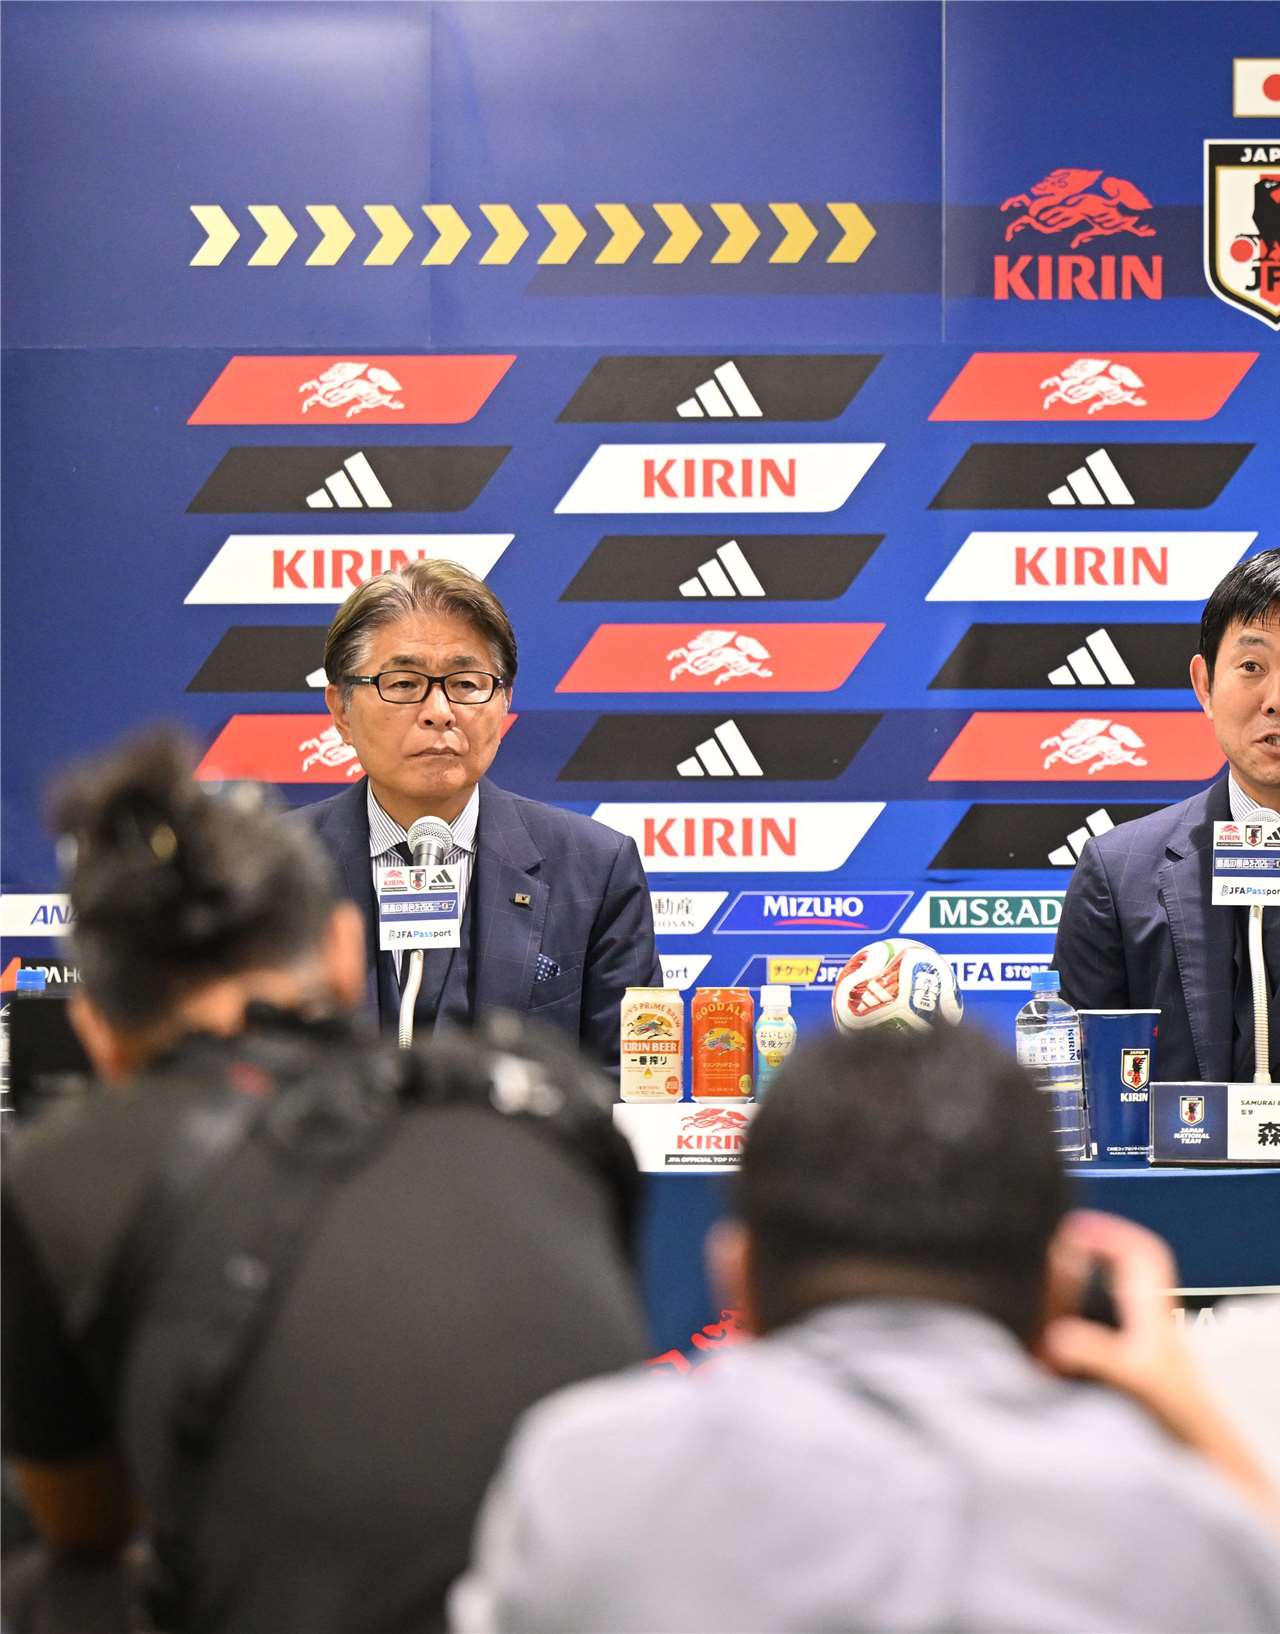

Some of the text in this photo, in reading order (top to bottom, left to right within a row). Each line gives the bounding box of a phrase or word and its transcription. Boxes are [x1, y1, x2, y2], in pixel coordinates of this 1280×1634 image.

[994, 255, 1162, 300] KIRIN
[644, 459, 796, 498] KIRIN
[1015, 547, 1167, 586] KIRIN
[644, 818, 796, 857] KIRIN
[763, 895, 864, 917] MIZUHO
[939, 899, 1062, 926] MS&AD
[774, 965, 814, 976] チケット
[623, 1042, 677, 1053] KIRIN BEER
[1067, 1029, 1076, 1061] KIRIN
[630, 1055, 668, 1066] 一番搾り
[1120, 1092, 1148, 1102] KIRIN
